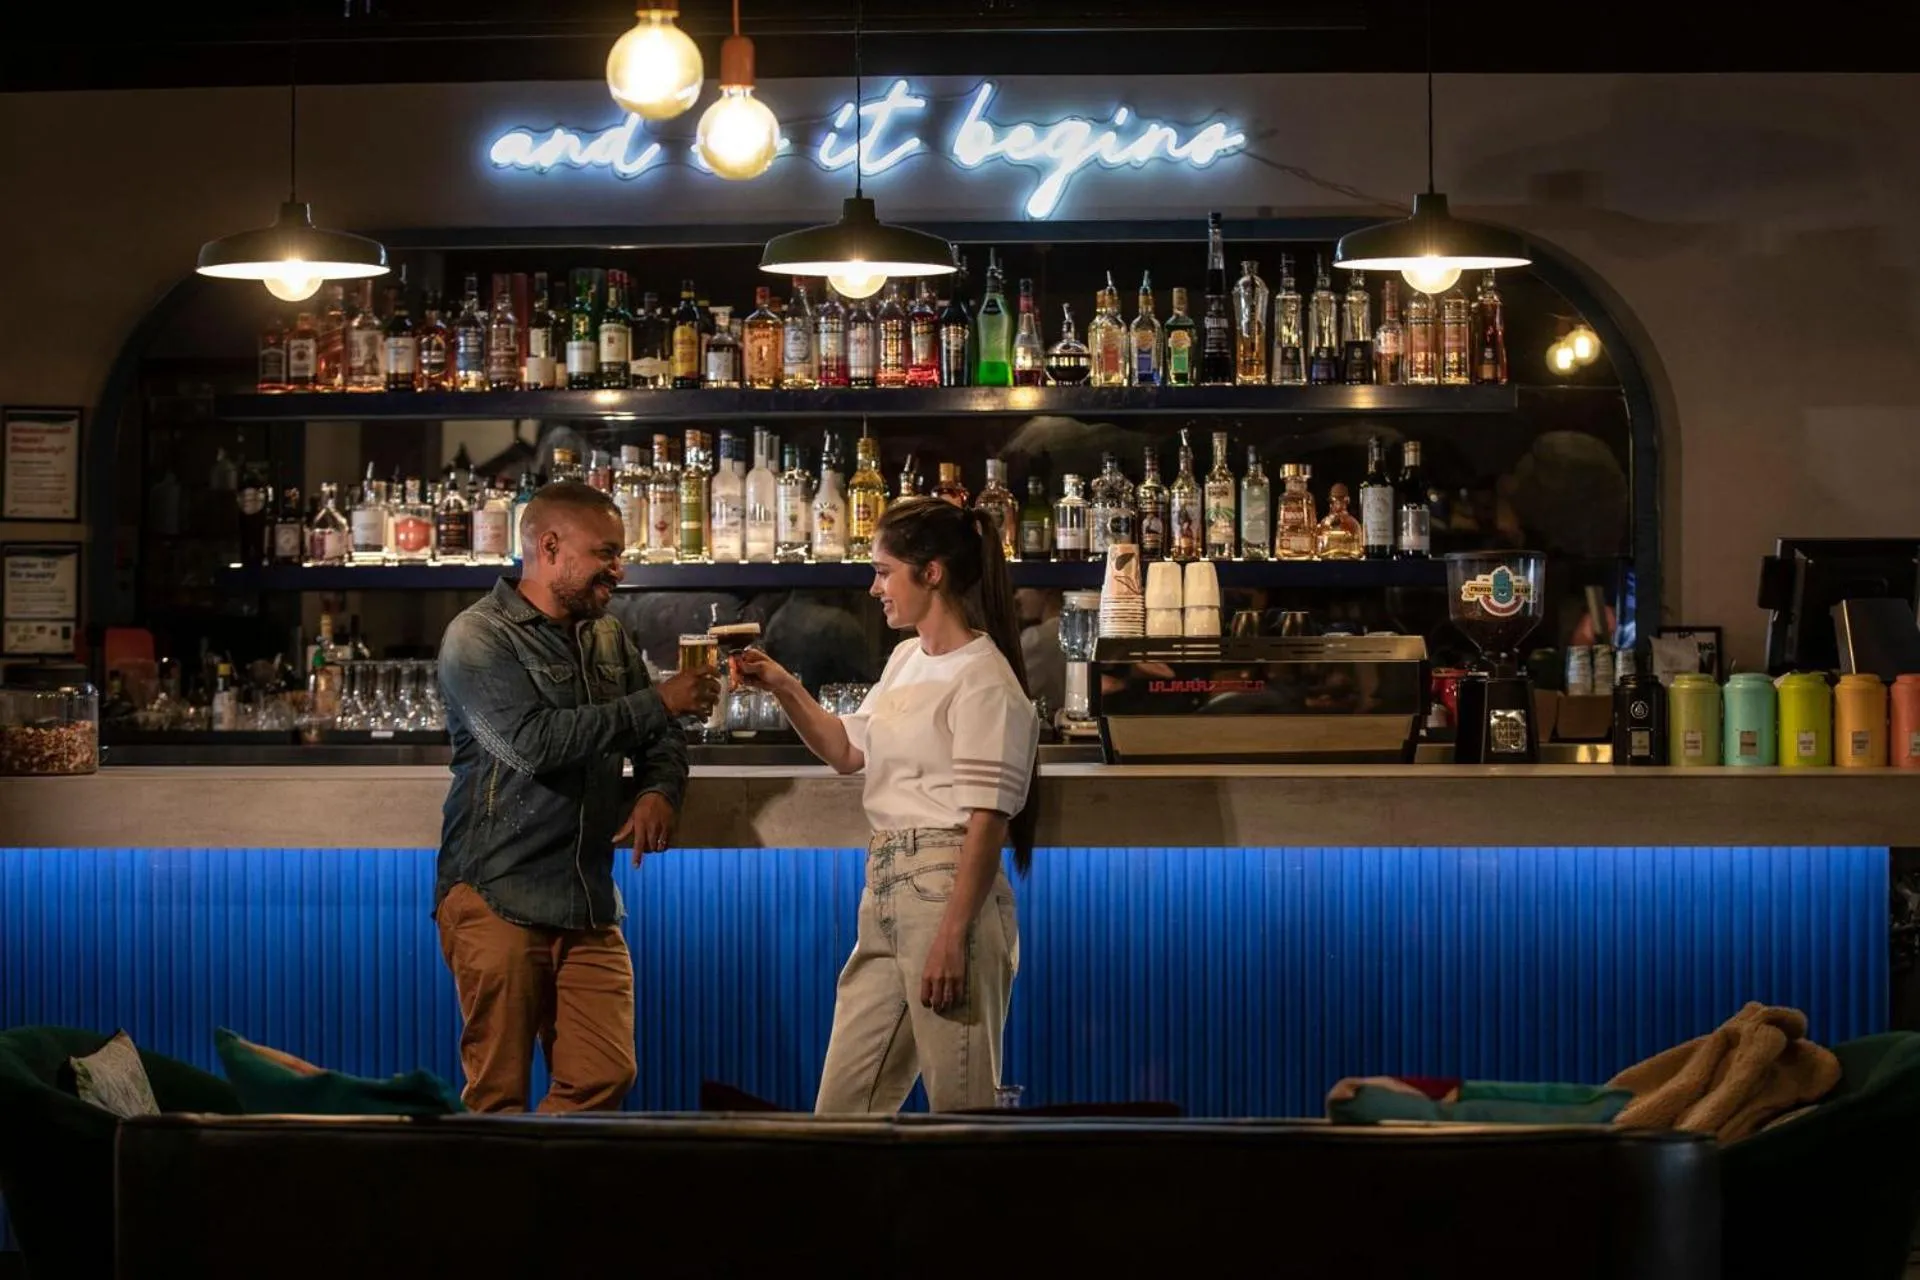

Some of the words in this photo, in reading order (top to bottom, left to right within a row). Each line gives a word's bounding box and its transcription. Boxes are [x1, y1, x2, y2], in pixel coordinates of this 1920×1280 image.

[490, 112, 661, 174] and
[818, 79, 927, 174] it
[952, 81, 1245, 219] begins
